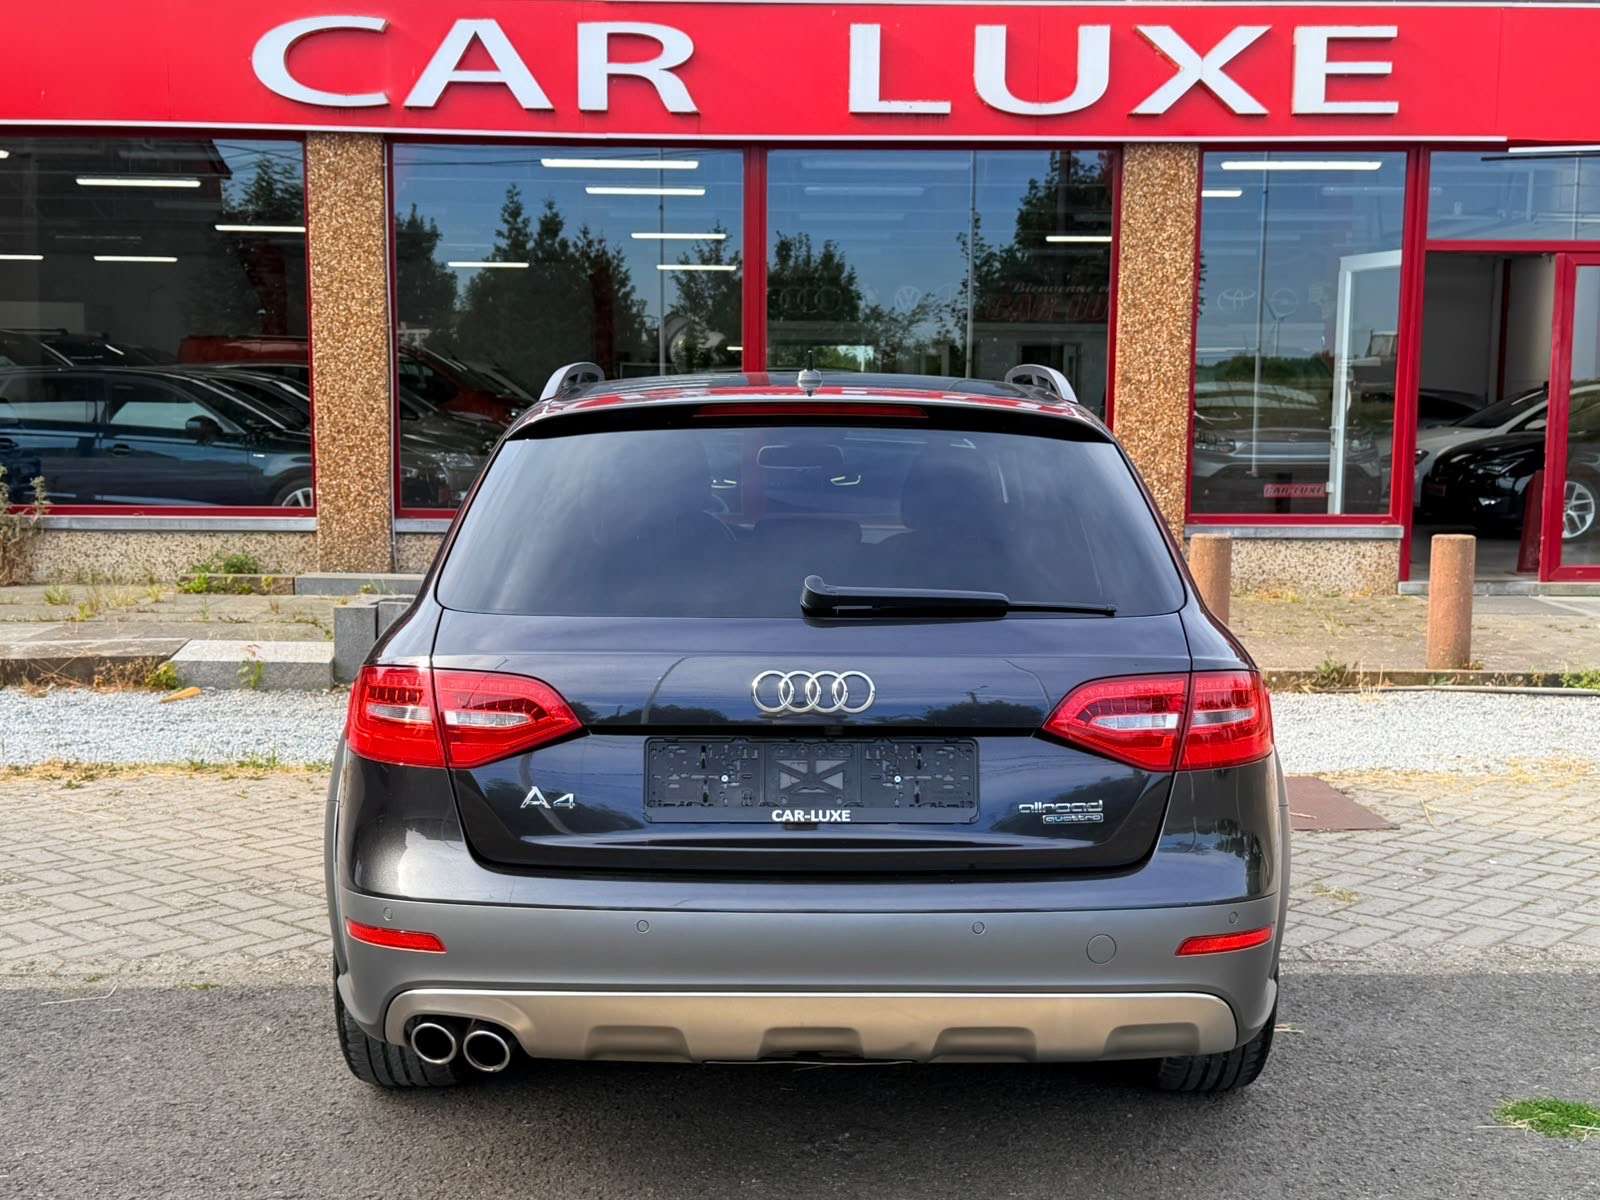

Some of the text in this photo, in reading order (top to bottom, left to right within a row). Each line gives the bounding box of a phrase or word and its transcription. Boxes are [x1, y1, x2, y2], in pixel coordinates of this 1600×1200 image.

[251, 15, 1400, 116] CAR LUXE
[520, 785, 576, 809] A4
[1018, 800, 1103, 813] allroad
[771, 809, 852, 822] CAR-LUXE
[1045, 814, 1101, 823] quattro
